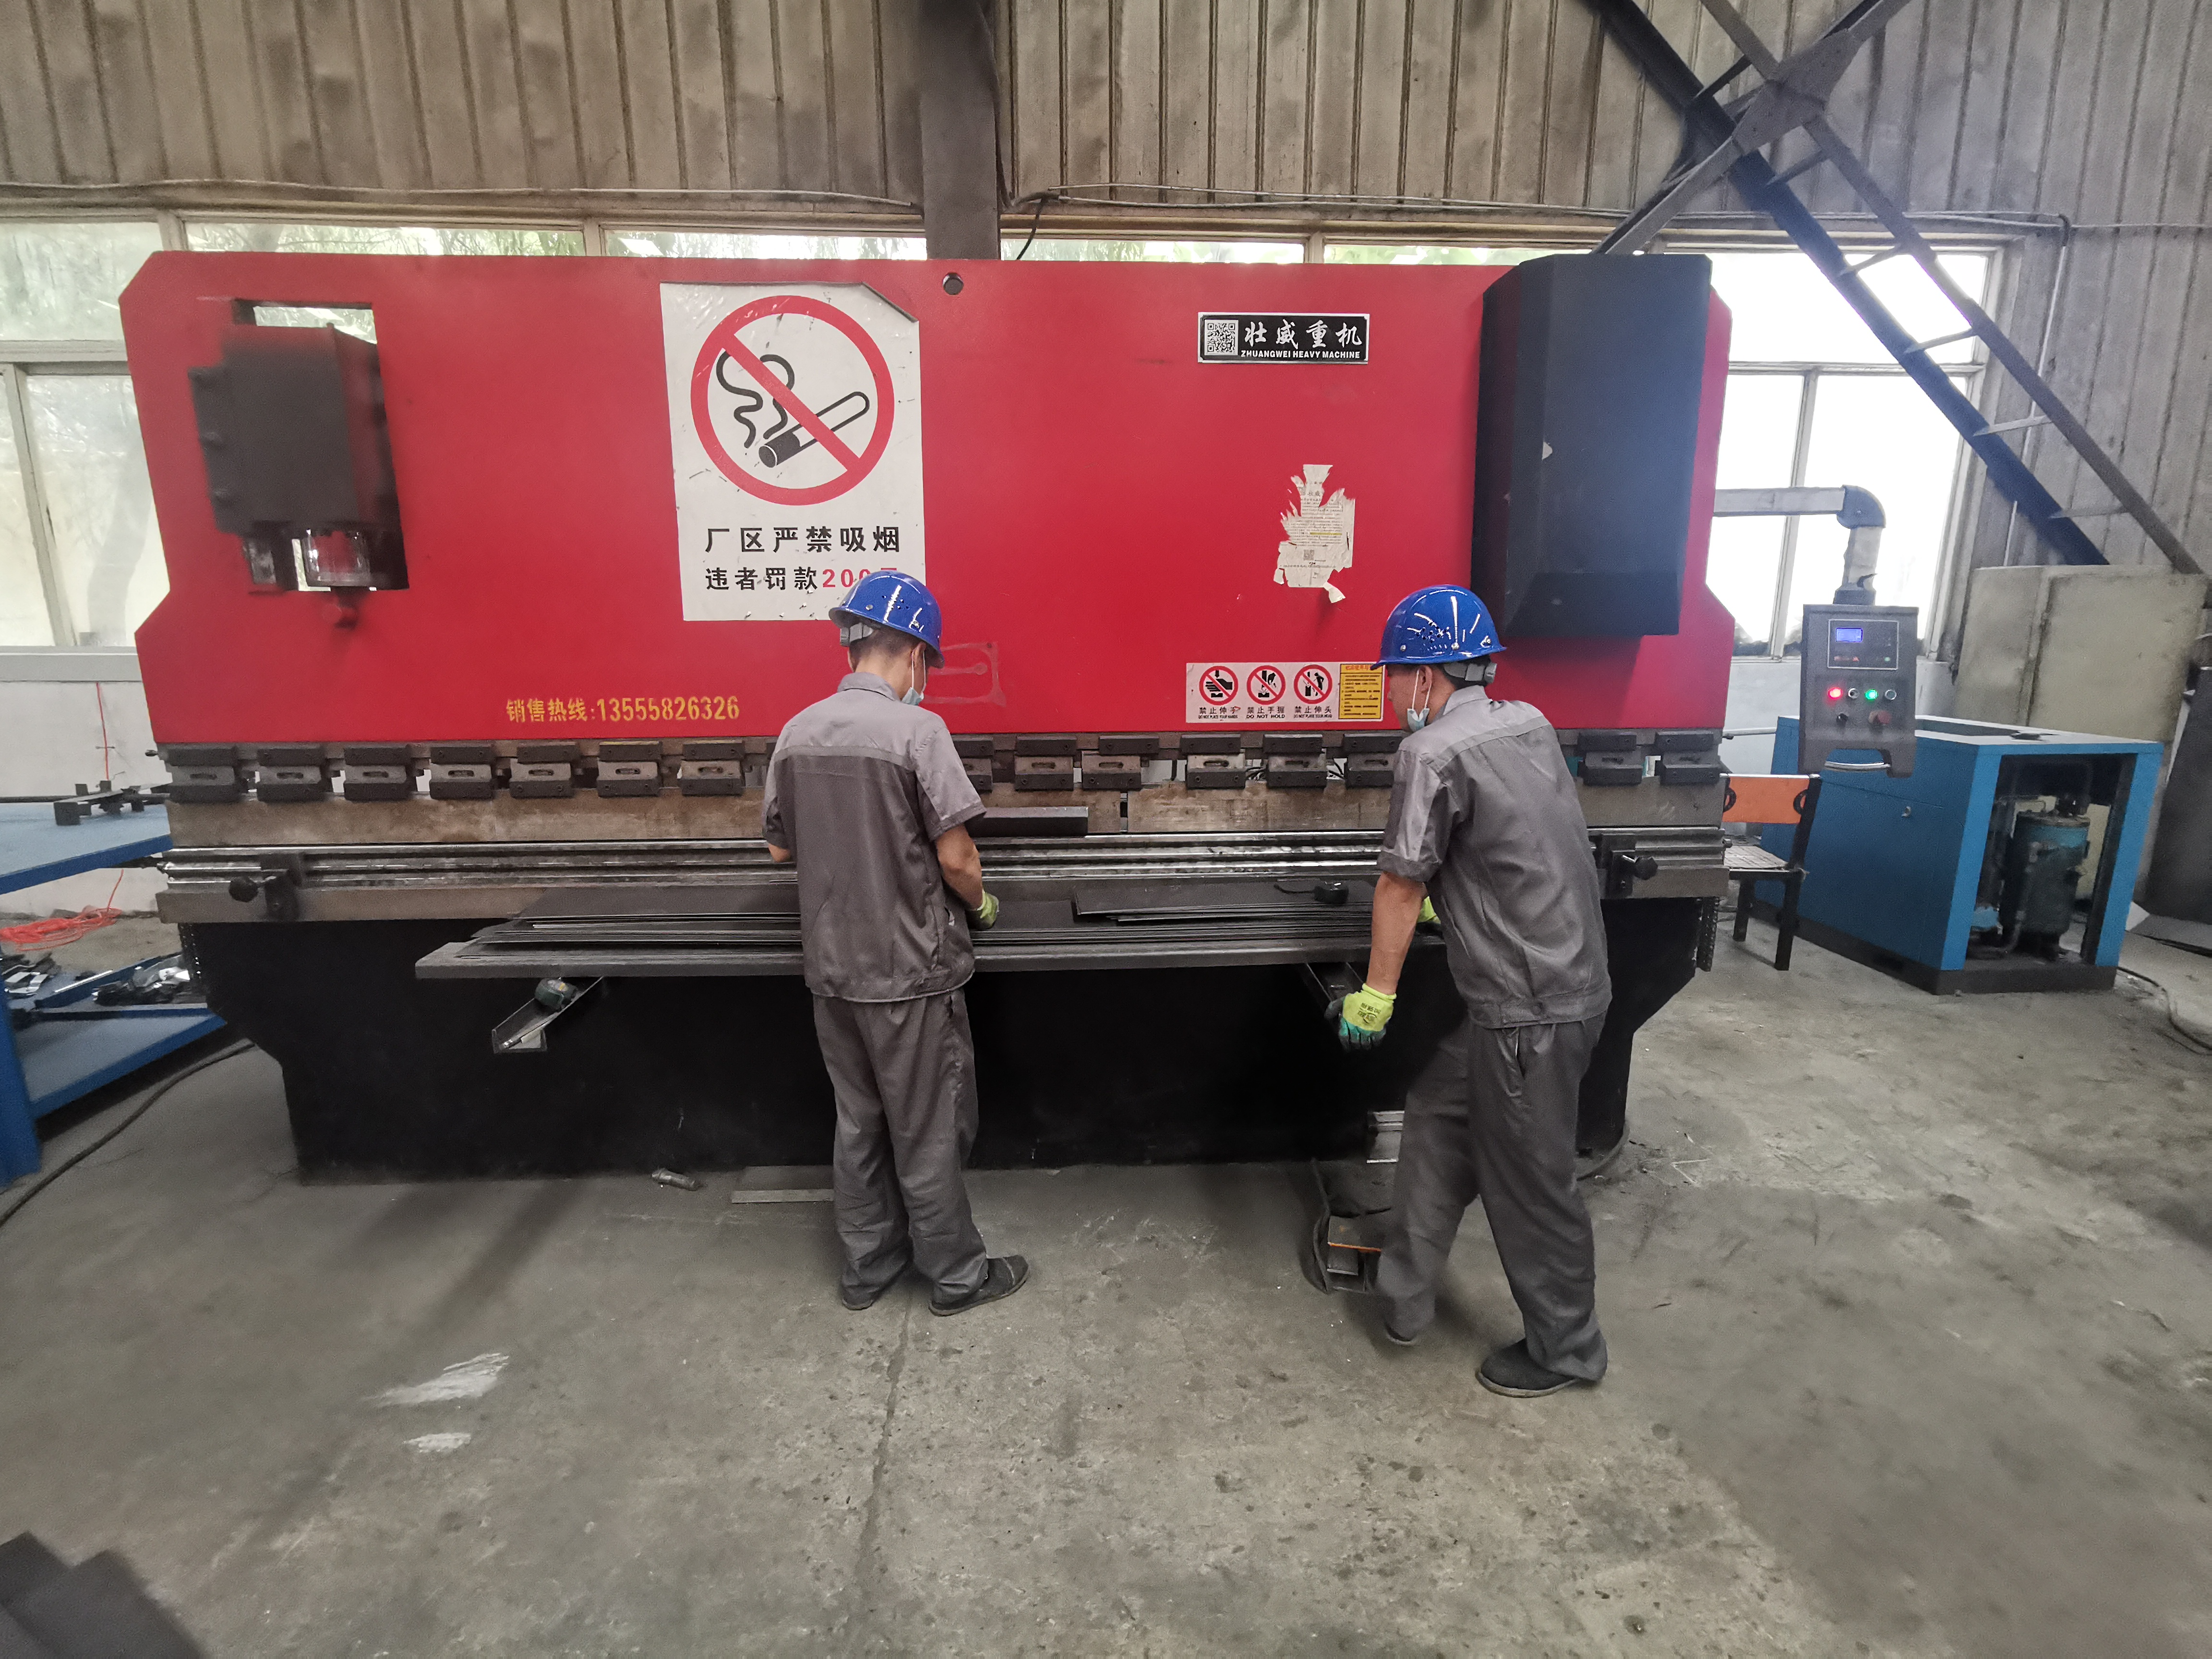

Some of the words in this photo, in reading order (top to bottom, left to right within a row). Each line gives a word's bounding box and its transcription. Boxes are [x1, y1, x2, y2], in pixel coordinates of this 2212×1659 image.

[1245, 319, 1362, 349] 壮威重机
[1241, 350, 1290, 358] ZHUANGWEI
[1293, 350, 1320, 359] HEAVY
[1322, 351, 1360, 359] MACHINE
[705, 525, 900, 553] 厂区严禁吸烟
[706, 566, 897, 591] 违者罚款20
